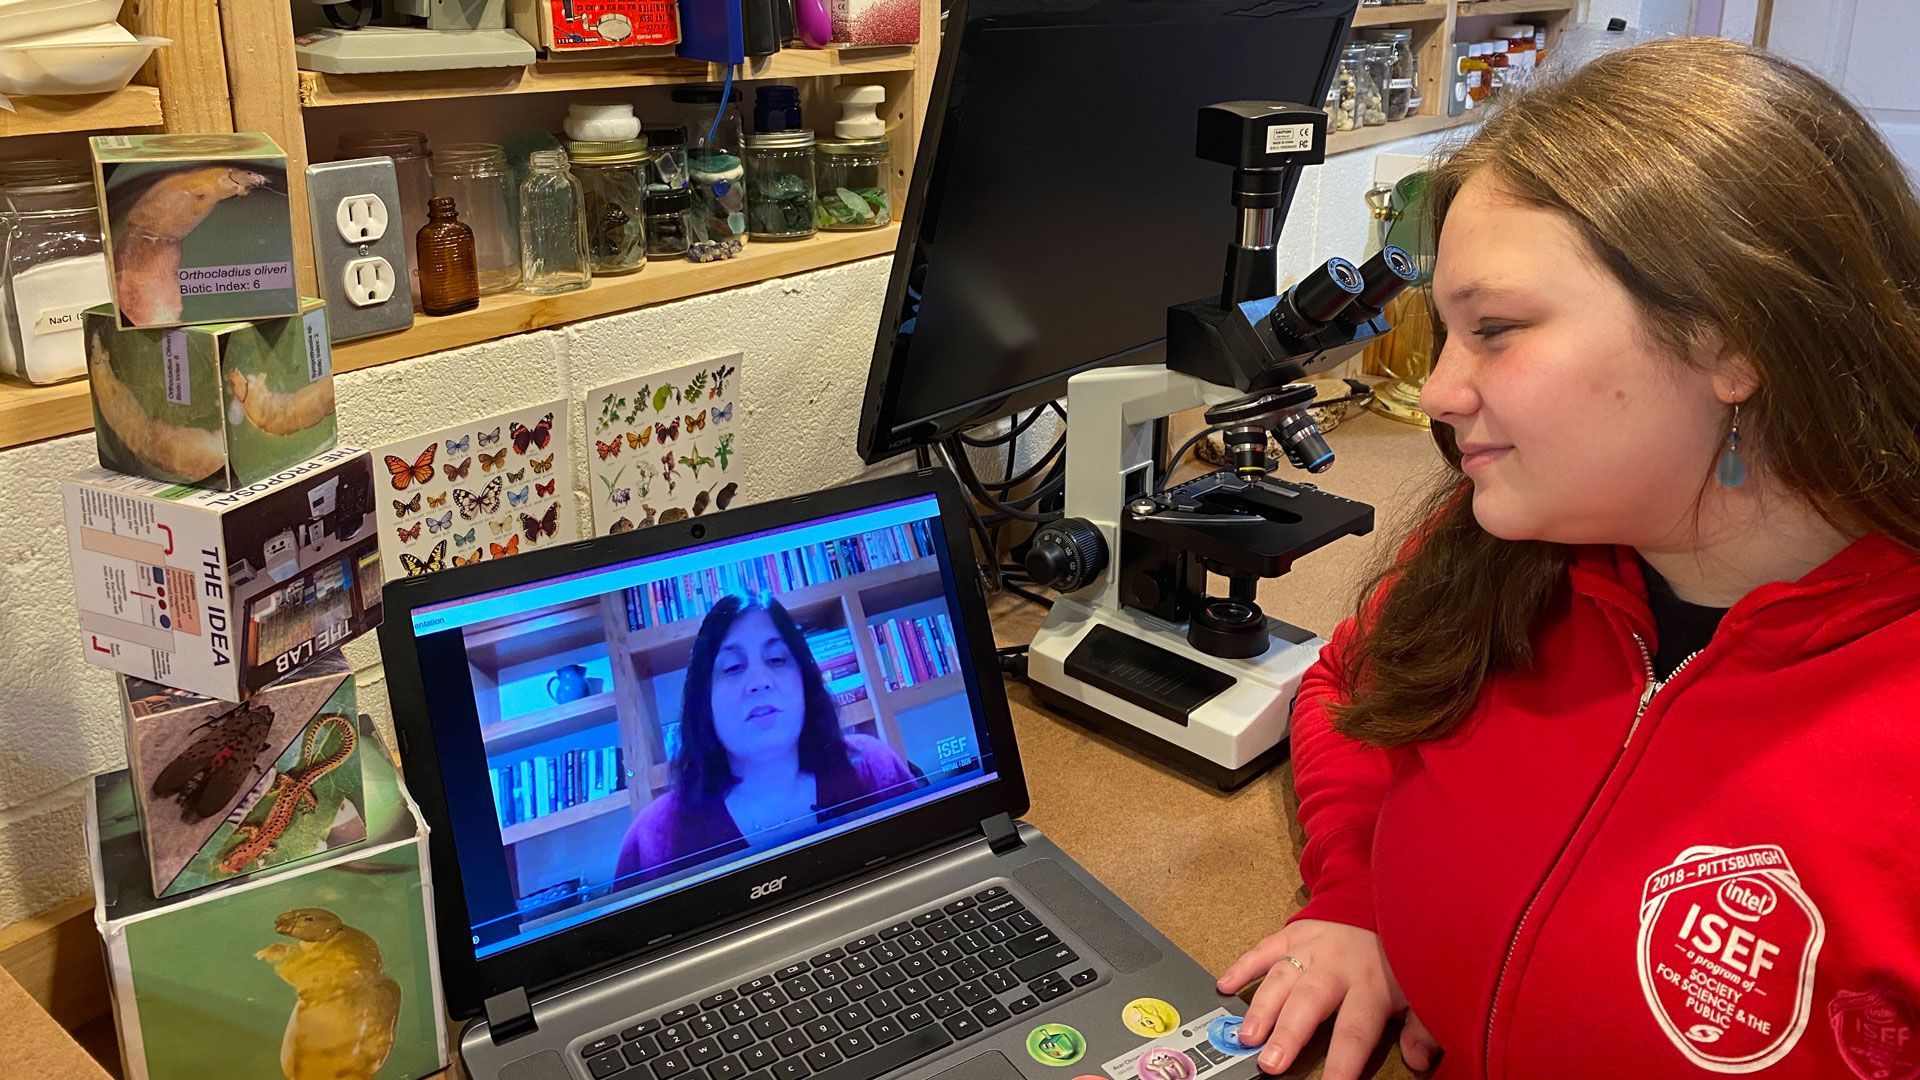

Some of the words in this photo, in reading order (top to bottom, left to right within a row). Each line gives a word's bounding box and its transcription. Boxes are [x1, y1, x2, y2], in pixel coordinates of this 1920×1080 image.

[179, 267, 251, 281] Orthocladius
[254, 264, 288, 276] oliveri
[180, 282, 212, 294] Biotic
[215, 281, 250, 292] Index:
[253, 280, 261, 289] 6
[49, 314, 72, 325] NaCl
[205, 462, 323, 506] PROPOSAL
[202, 547, 223, 600] THE
[207, 605, 230, 667] IDEA
[315, 619, 353, 652] THE
[277, 643, 313, 673] LAB
[938, 736, 967, 759] ISEF
[751, 876, 787, 899] acer
[1650, 868, 1685, 893] 2018
[1697, 850, 1782, 878] PITTSBURGH
[988, 900, 1014, 912] backspace
[1725, 879, 1768, 914] intel
[1056, 950, 1068, 958] shift
[1678, 903, 1781, 979] ISEF
[1688, 968, 1743, 1003] SOCIETY
[1695, 954, 1742, 984] program
[1742, 979, 1756, 994] of
[1656, 962, 1681, 984] FOR
[1681, 979, 1736, 1016] SCIENCE
[1735, 1009, 1746, 1022] &
[1746, 1014, 1772, 1036] THE
[1685, 998, 1732, 1030] PUBLIC
